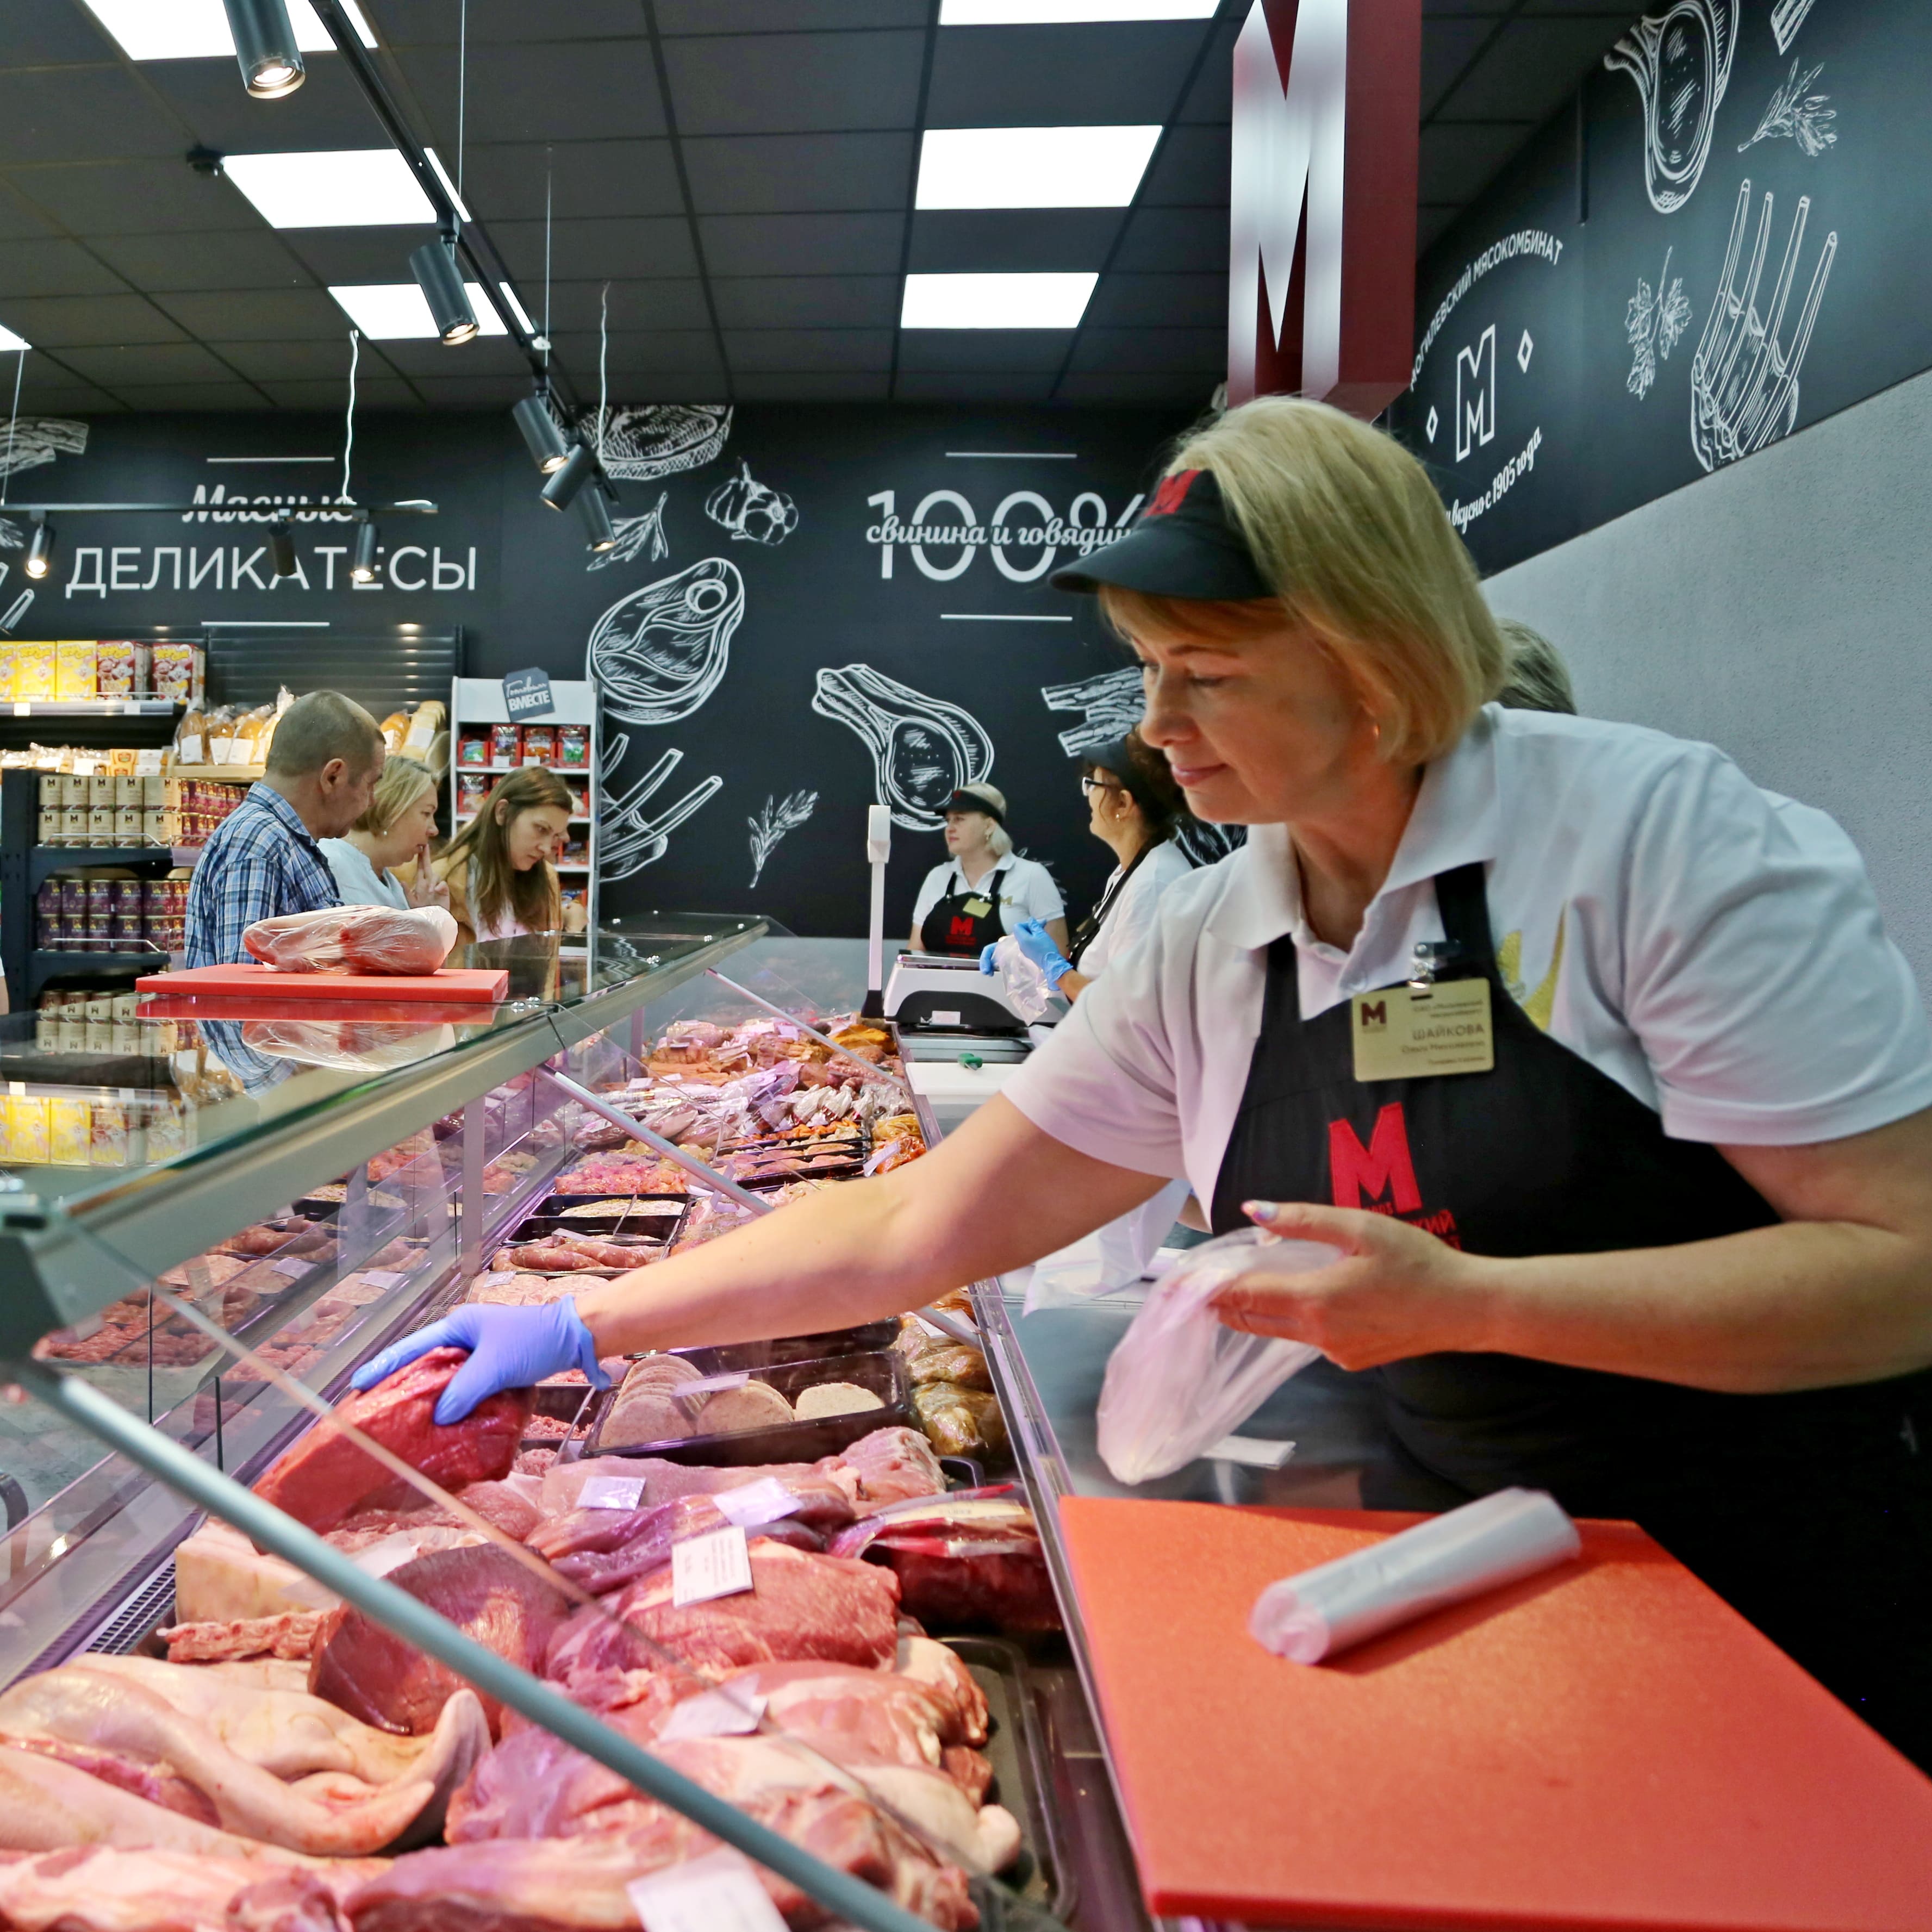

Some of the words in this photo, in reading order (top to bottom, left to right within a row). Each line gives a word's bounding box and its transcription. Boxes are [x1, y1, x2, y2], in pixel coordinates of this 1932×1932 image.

[1473, 229, 1563, 282] МЯСОКОМБИНАТ
[1451, 498, 1485, 535] вкусно
[1485, 490, 1492, 509] с
[1492, 457, 1516, 503] 1905
[1516, 426, 1542, 476] года
[865, 515, 988, 544] свинина
[993, 526, 1012, 544] и
[1018, 517, 1131, 557] говядин
[508, 690, 551, 712] ВМЕСТЕ
[1412, 1023, 1485, 1040] ШАЙКОВА
